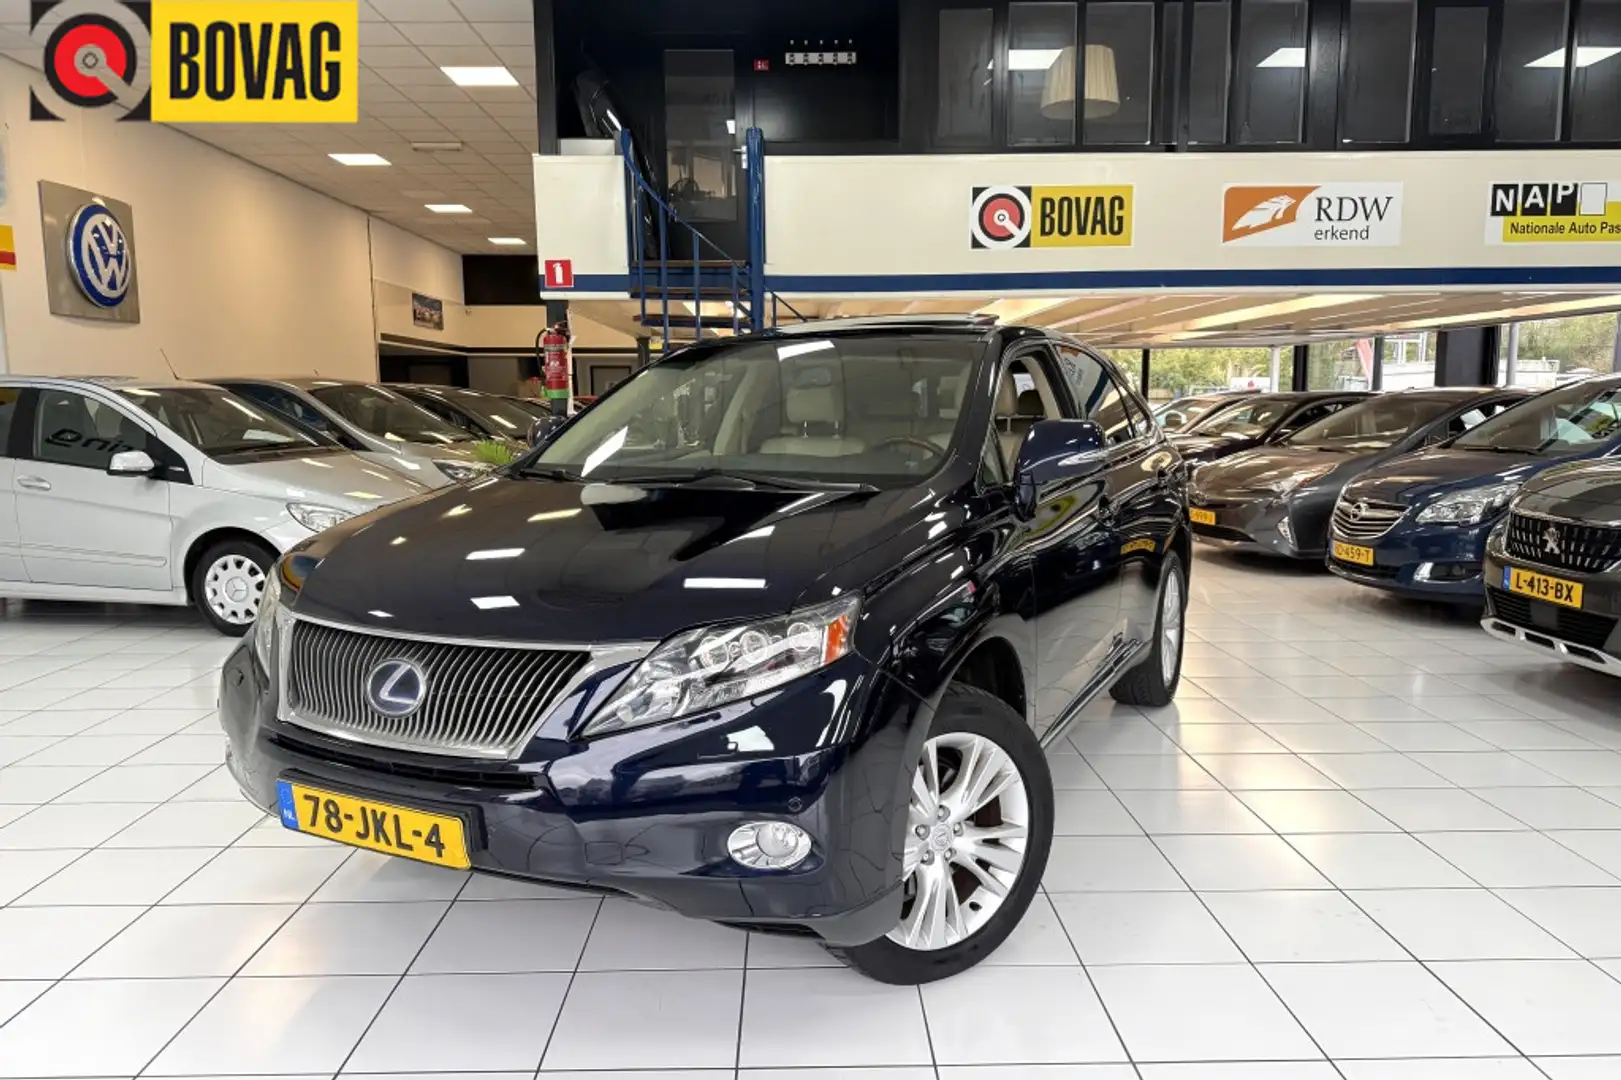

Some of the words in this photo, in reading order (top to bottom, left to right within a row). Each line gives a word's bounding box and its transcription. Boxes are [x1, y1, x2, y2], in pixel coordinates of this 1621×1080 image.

[1314, 195, 1394, 222] RDW
[1495, 183, 1575, 212] NAP
[1040, 194, 1125, 237] BOVAG
[1510, 221, 1565, 234] Nationale
[1568, 221, 1597, 234] Auto
[1314, 225, 1369, 241] erkend
[1515, 572, 1574, 603] L-413-BX
[303, 794, 446, 858] 78-JKL-4
